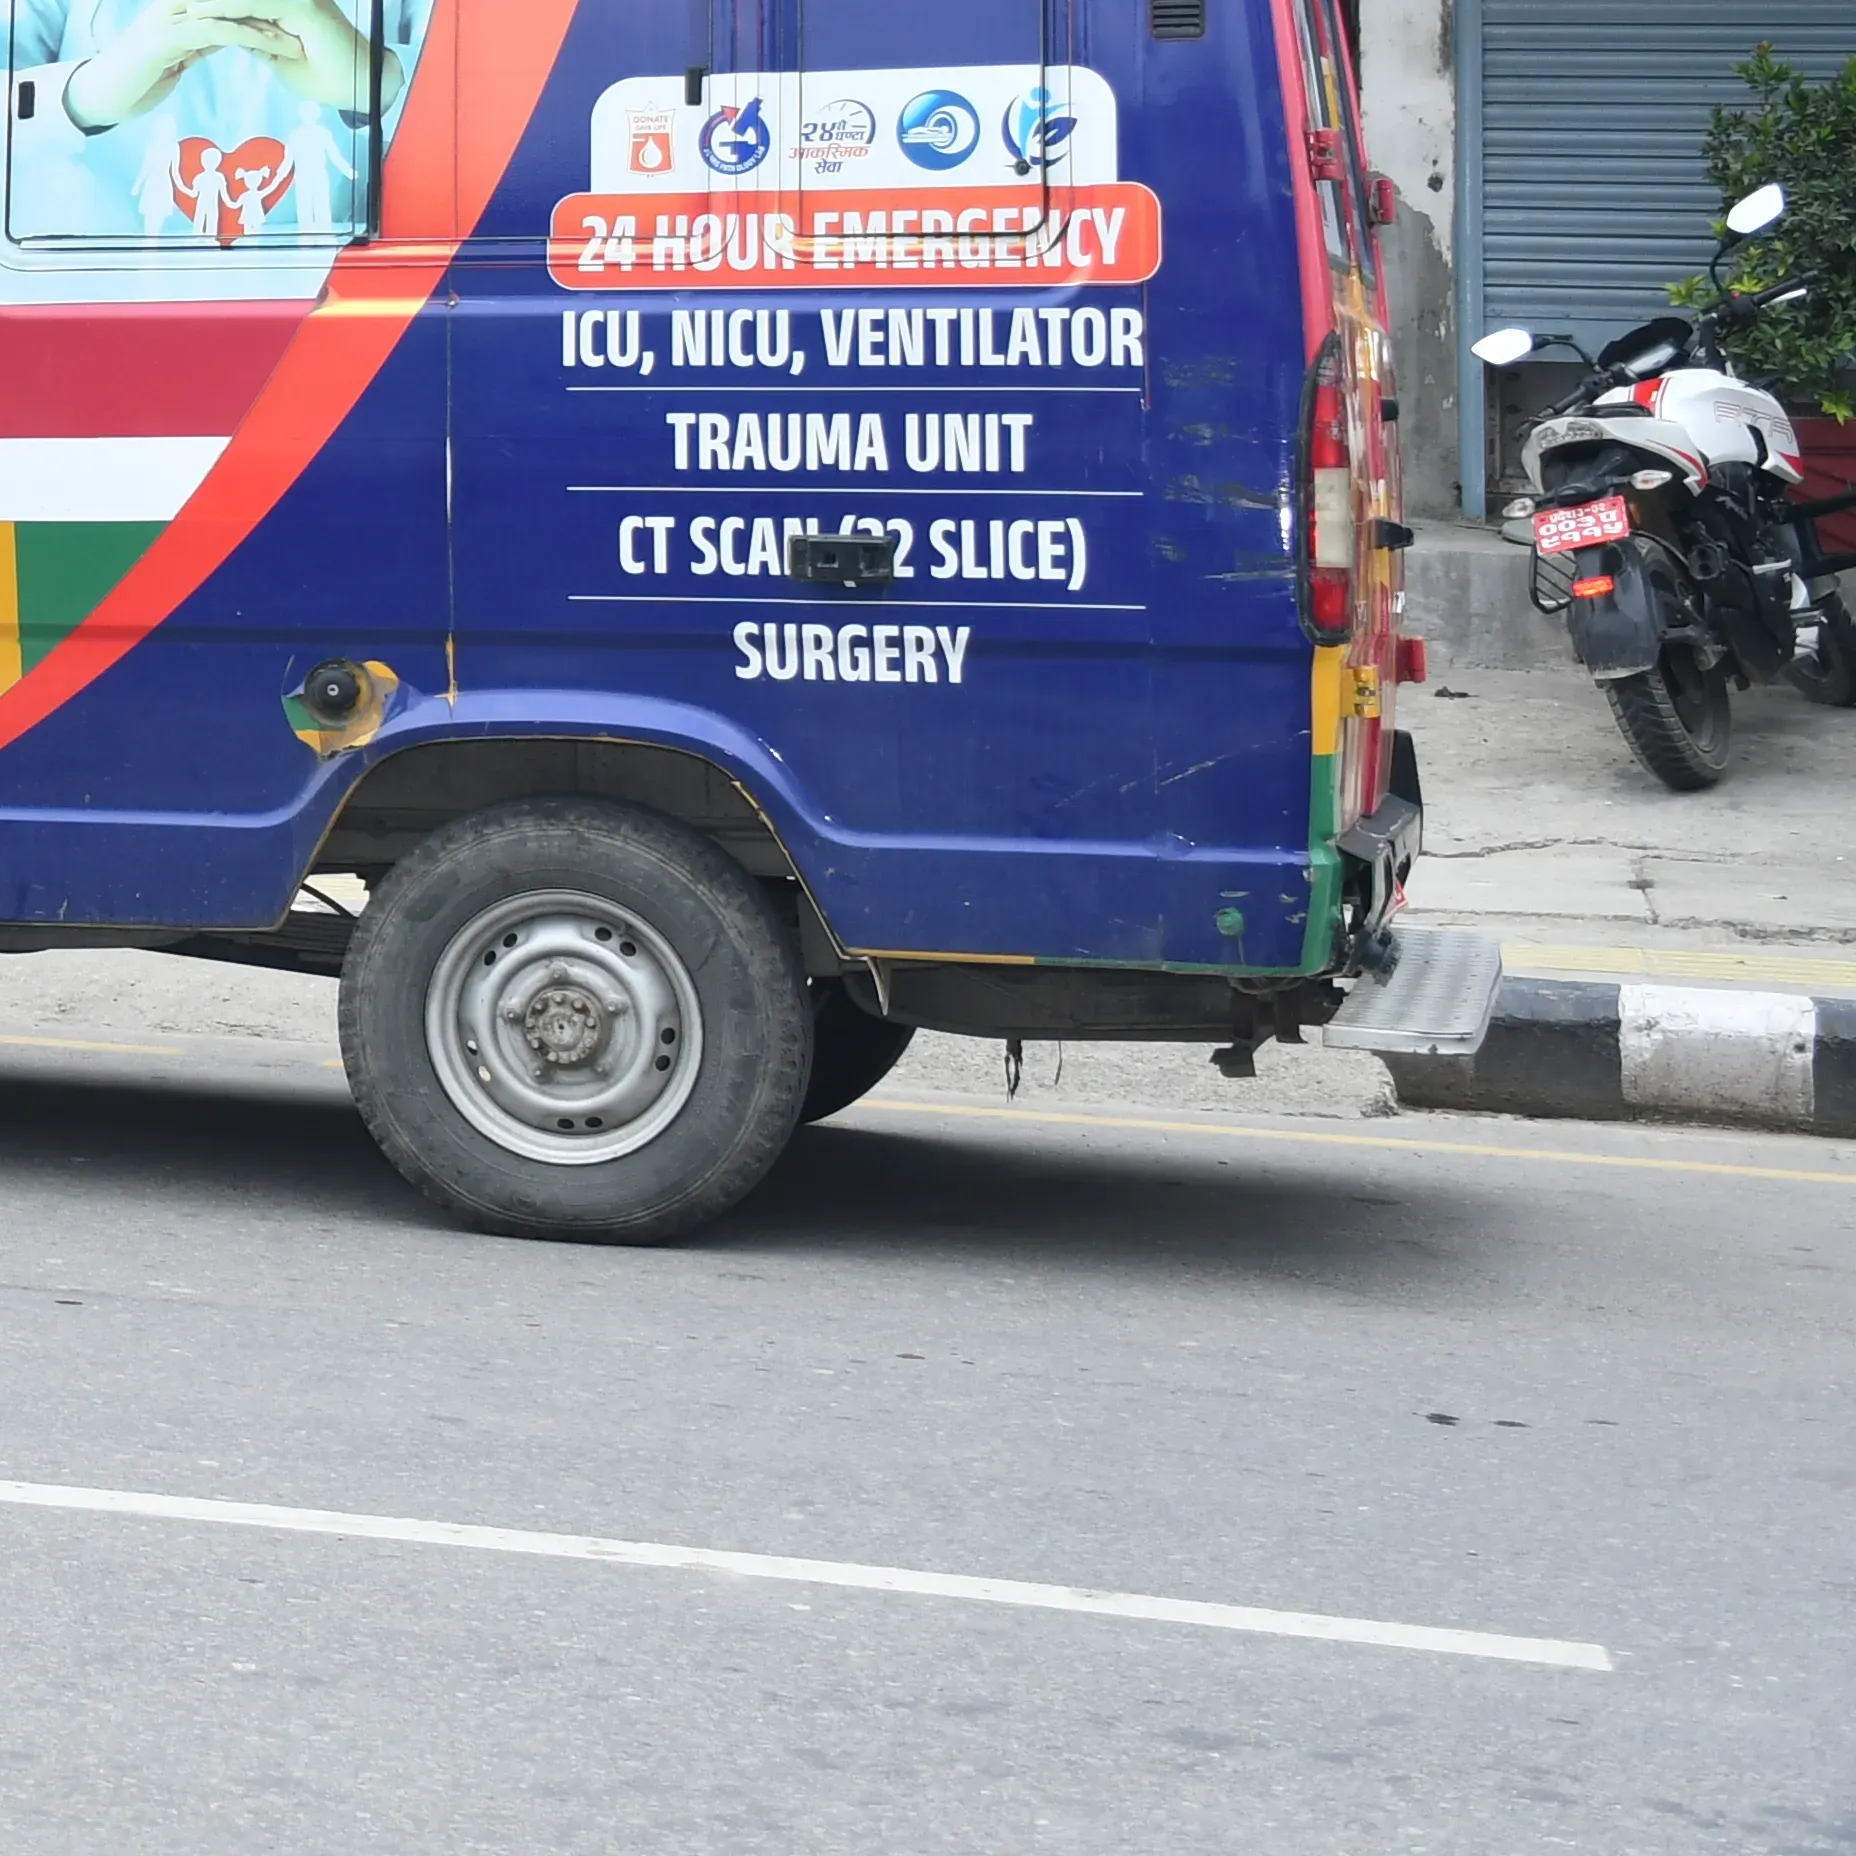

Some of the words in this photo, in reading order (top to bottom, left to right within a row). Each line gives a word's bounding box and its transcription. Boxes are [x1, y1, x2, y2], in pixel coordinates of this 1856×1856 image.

[814, 157, 844, 175] सेवा
[577, 214, 637, 272] 24
[654, 212, 796, 272] HOUR
[812, 206, 1126, 269] EMERGENCY
[562, 310, 655, 375] ICU,
[671, 308, 805, 375] NICU,
[821, 306, 1144, 367] VENTILATOR
[666, 412, 888, 471] TRAUMA
[905, 413, 1033, 472] UNIT
[619, 516, 675, 574] CT
[929, 518, 1087, 591] SLICE)
[733, 621, 971, 685] SURGERY
